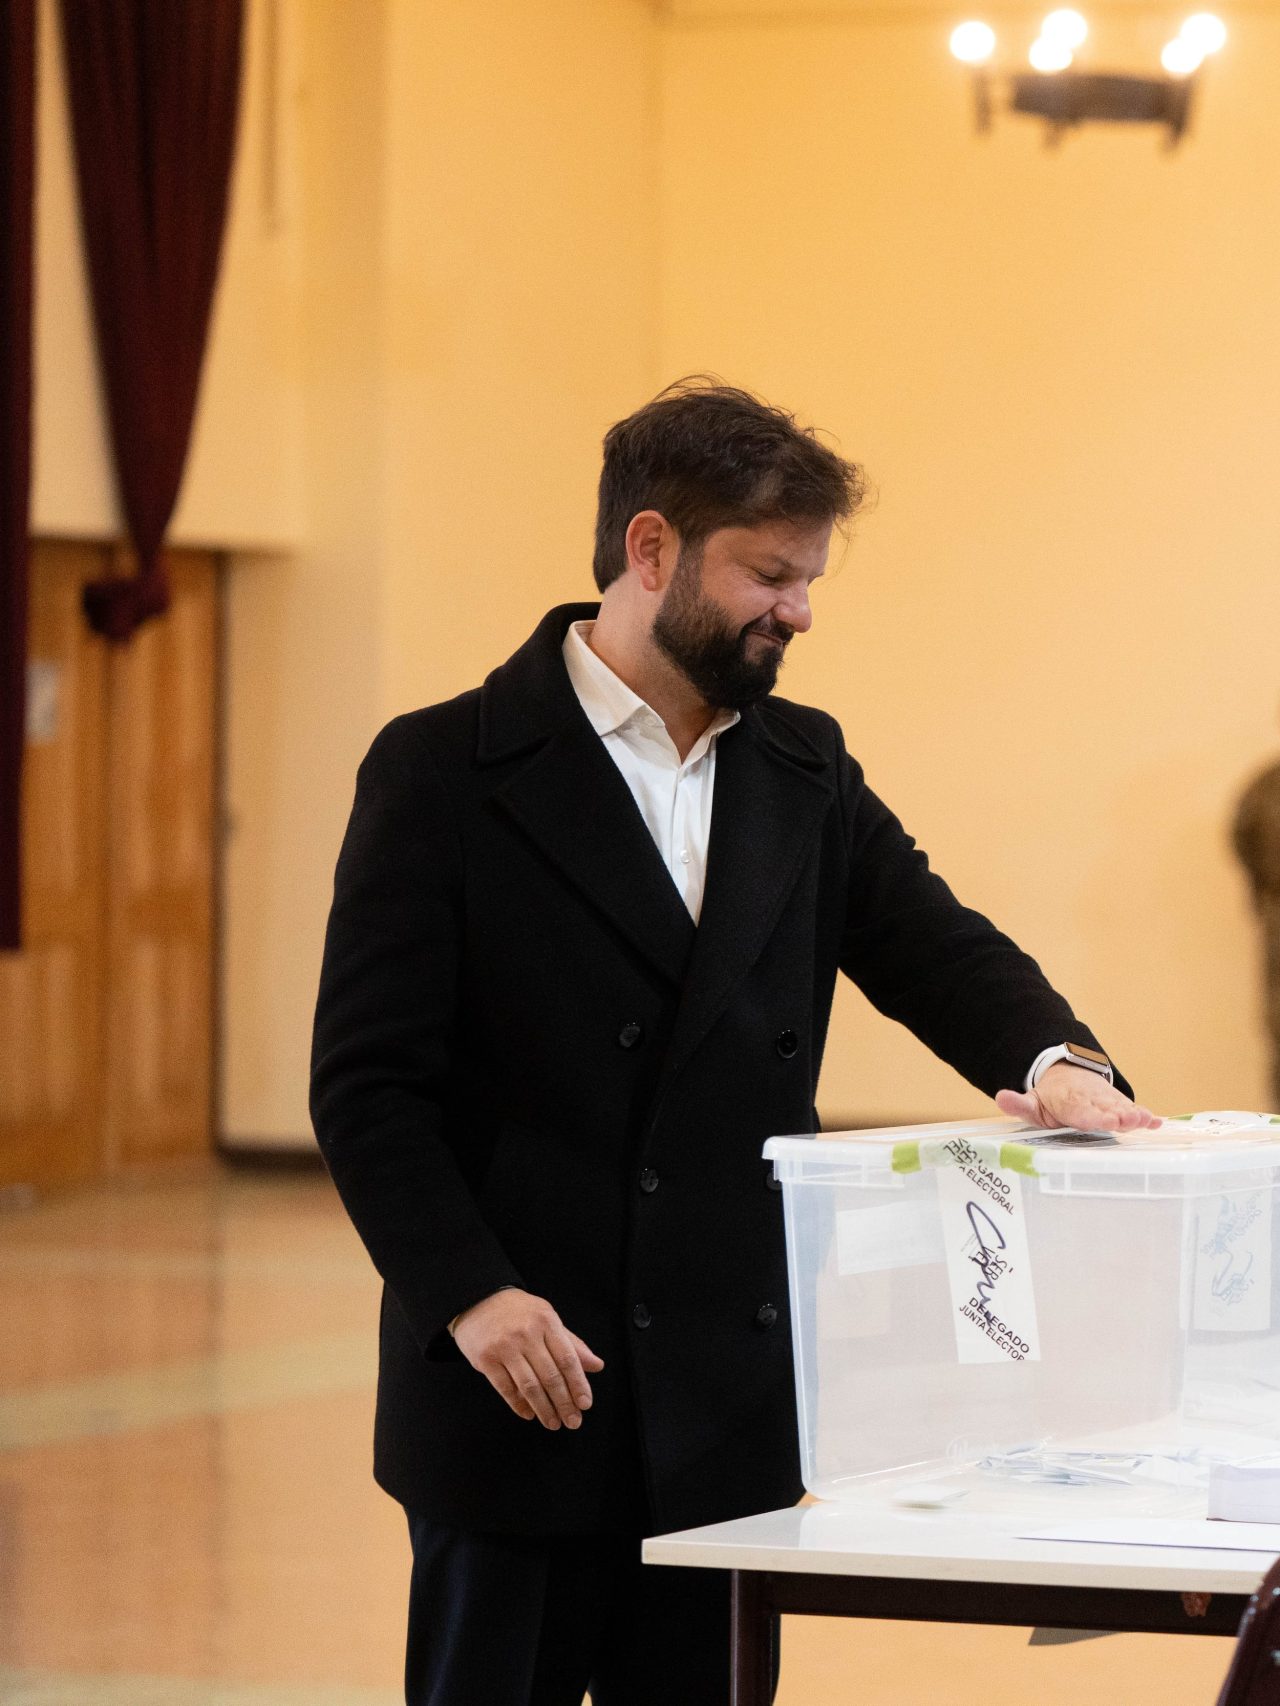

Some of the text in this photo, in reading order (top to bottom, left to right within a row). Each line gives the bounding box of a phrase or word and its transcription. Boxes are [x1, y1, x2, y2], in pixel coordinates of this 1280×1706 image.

[966, 1168, 1014, 1216] ELECTORAL
[959, 1304, 986, 1331] JUNTA
[968, 1297, 1030, 1354] DELEGADO
